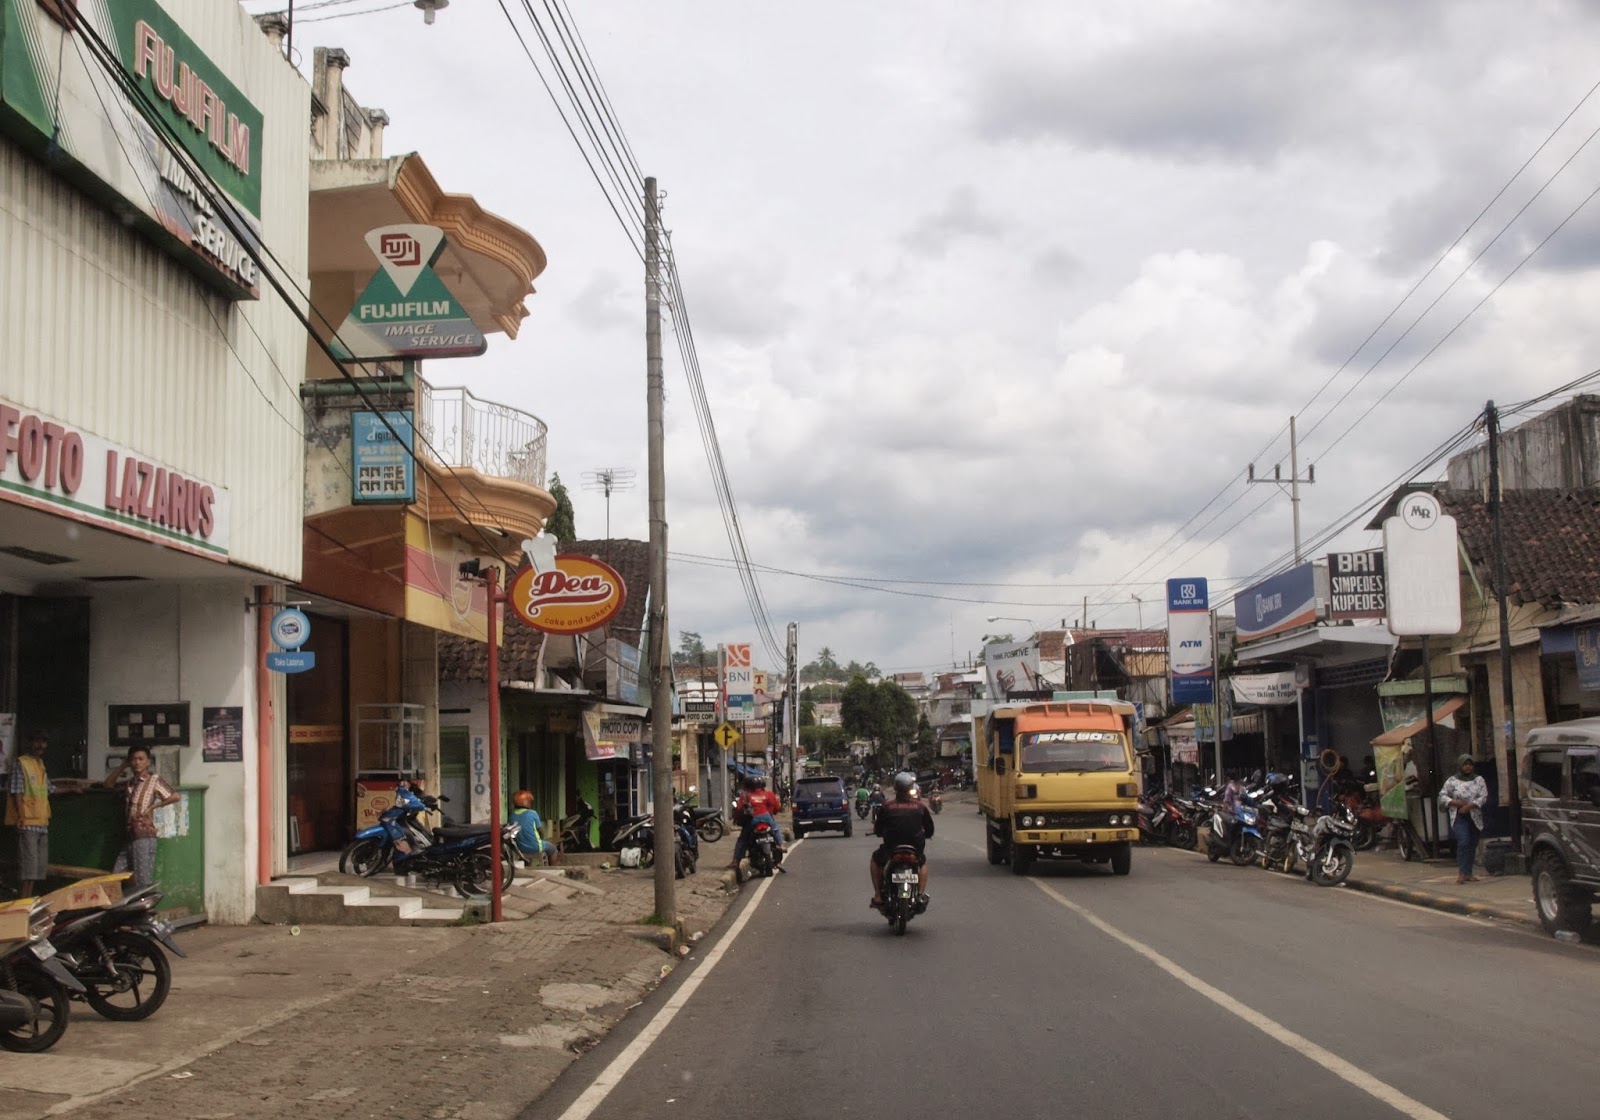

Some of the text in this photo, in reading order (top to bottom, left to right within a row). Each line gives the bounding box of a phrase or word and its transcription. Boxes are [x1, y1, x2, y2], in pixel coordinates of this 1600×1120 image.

[134, 19, 249, 175] FUJIFILM
[191, 214, 256, 286] SERVICE
[360, 300, 450, 319] FUJIFILM
[385, 324, 435, 336] IMAGE
[411, 334, 475, 347] SERVICE
[0, 403, 215, 538] FOTO LAZARUS
[1411, 505, 1431, 519] MR
[1337, 553, 1375, 572] BRI
[528, 569, 610, 602] Dea
[1332, 575, 1383, 593] SIMPEDES
[1332, 593, 1385, 612] KUPEDES
[544, 602, 612, 626] cake and bakery
[1004, 646, 1029, 659] POSITIVE
[1179, 640, 1202, 648] ATM
[729, 671, 750, 682] BNI
[1267, 683, 1279, 691] Aki
[601, 722, 621, 734] PHOTO
[622, 722, 640, 734] COPY
[474, 736, 485, 796] PHOTO
